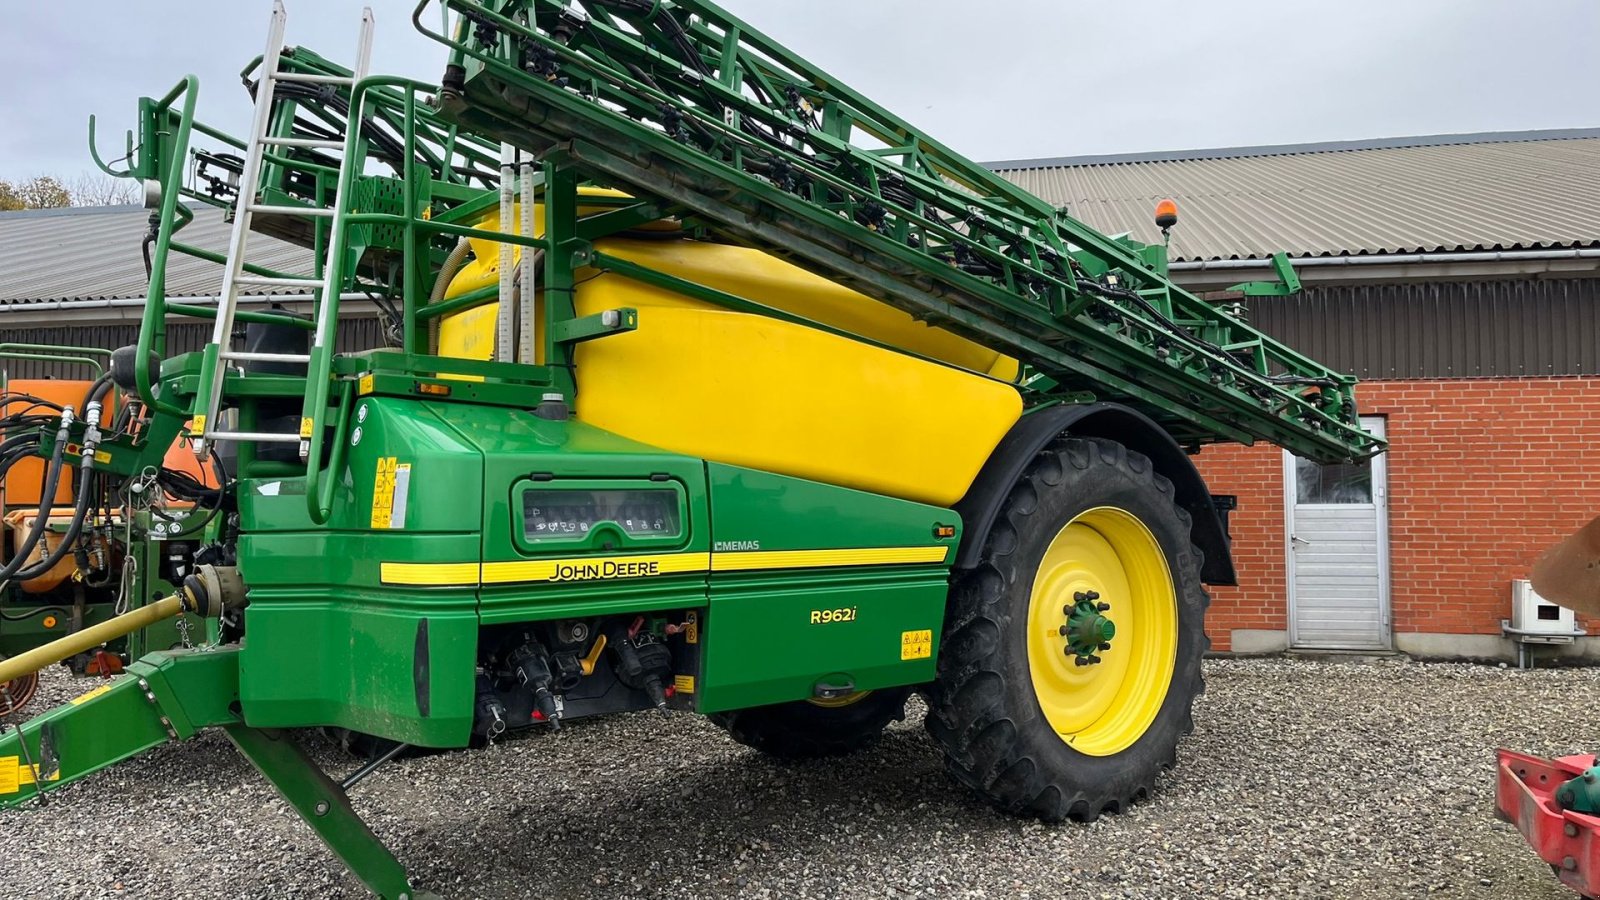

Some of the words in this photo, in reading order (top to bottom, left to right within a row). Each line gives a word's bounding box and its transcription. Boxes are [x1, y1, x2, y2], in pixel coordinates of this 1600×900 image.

[722, 540, 760, 551] MEMAS
[550, 564, 598, 580] JOHN
[603, 561, 659, 576] DEERE
[810, 605, 857, 624] R962i
